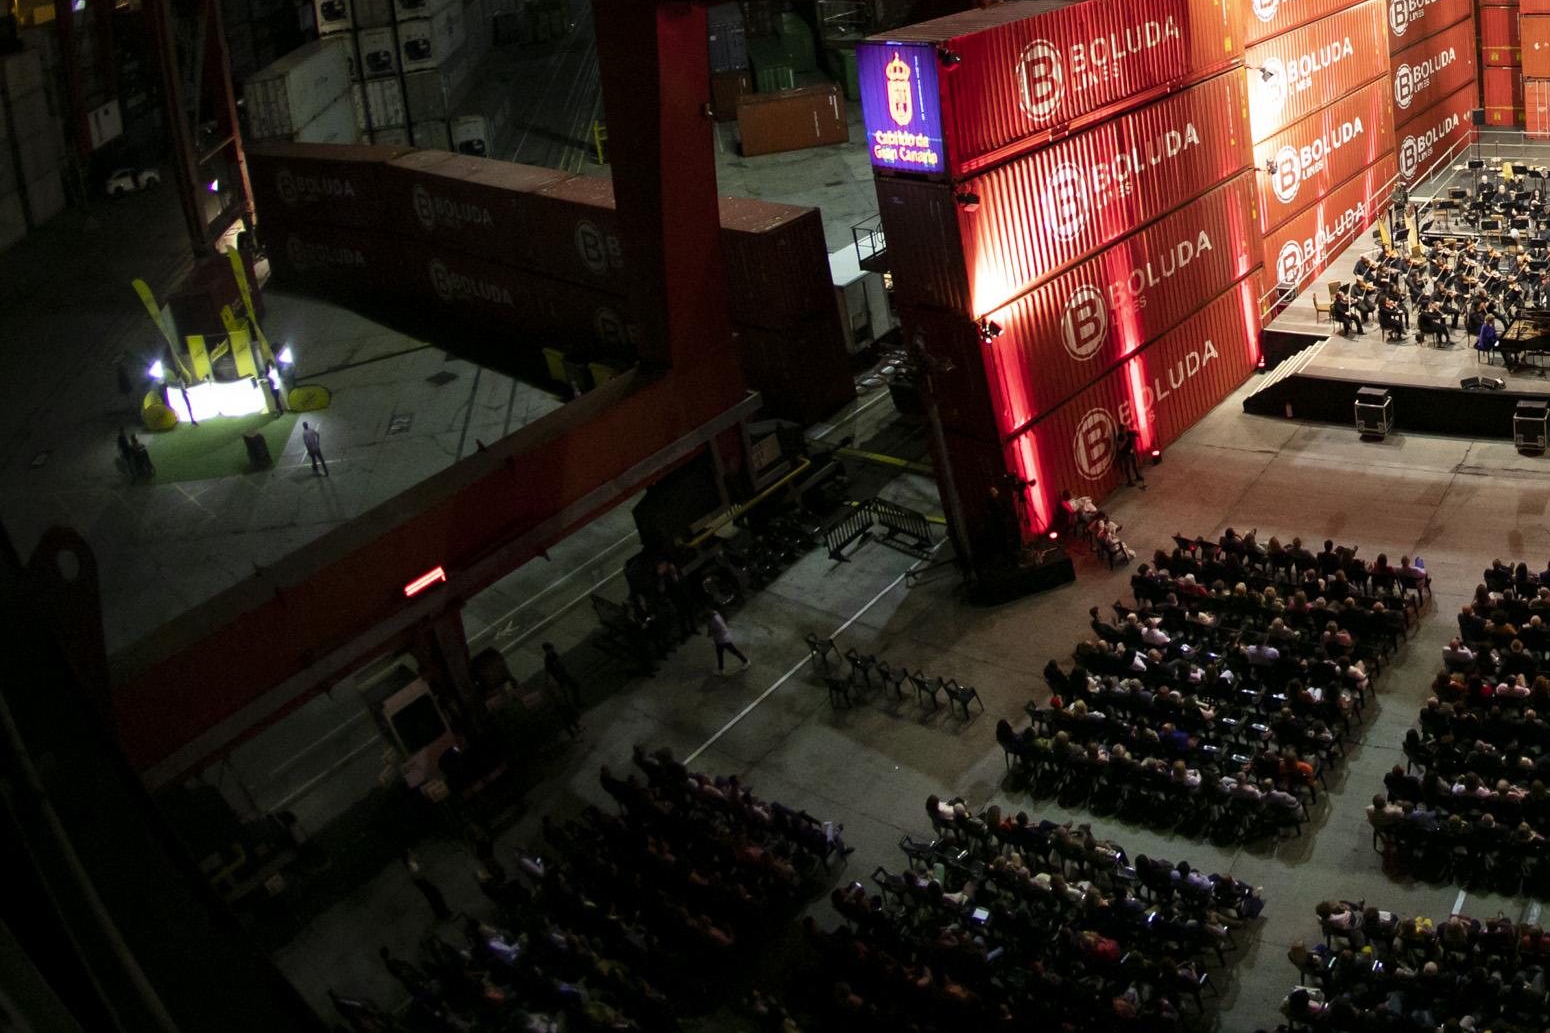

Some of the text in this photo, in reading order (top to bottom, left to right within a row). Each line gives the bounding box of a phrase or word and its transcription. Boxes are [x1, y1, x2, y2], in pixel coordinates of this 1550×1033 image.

[1070, 15, 1180, 74] BOLUDA
[1287, 37, 1354, 83] BOLUDA
[1413, 47, 1456, 83] BOLUDA
[874, 130, 929, 148] Cabildo de
[874, 145, 938, 166] Gran Canaria
[1300, 116, 1364, 169] BOLUDA
[1417, 112, 1459, 153] BOLUDA
[1091, 122, 1200, 194] BOLUDA
[1108, 229, 1213, 310] BOLUDA
